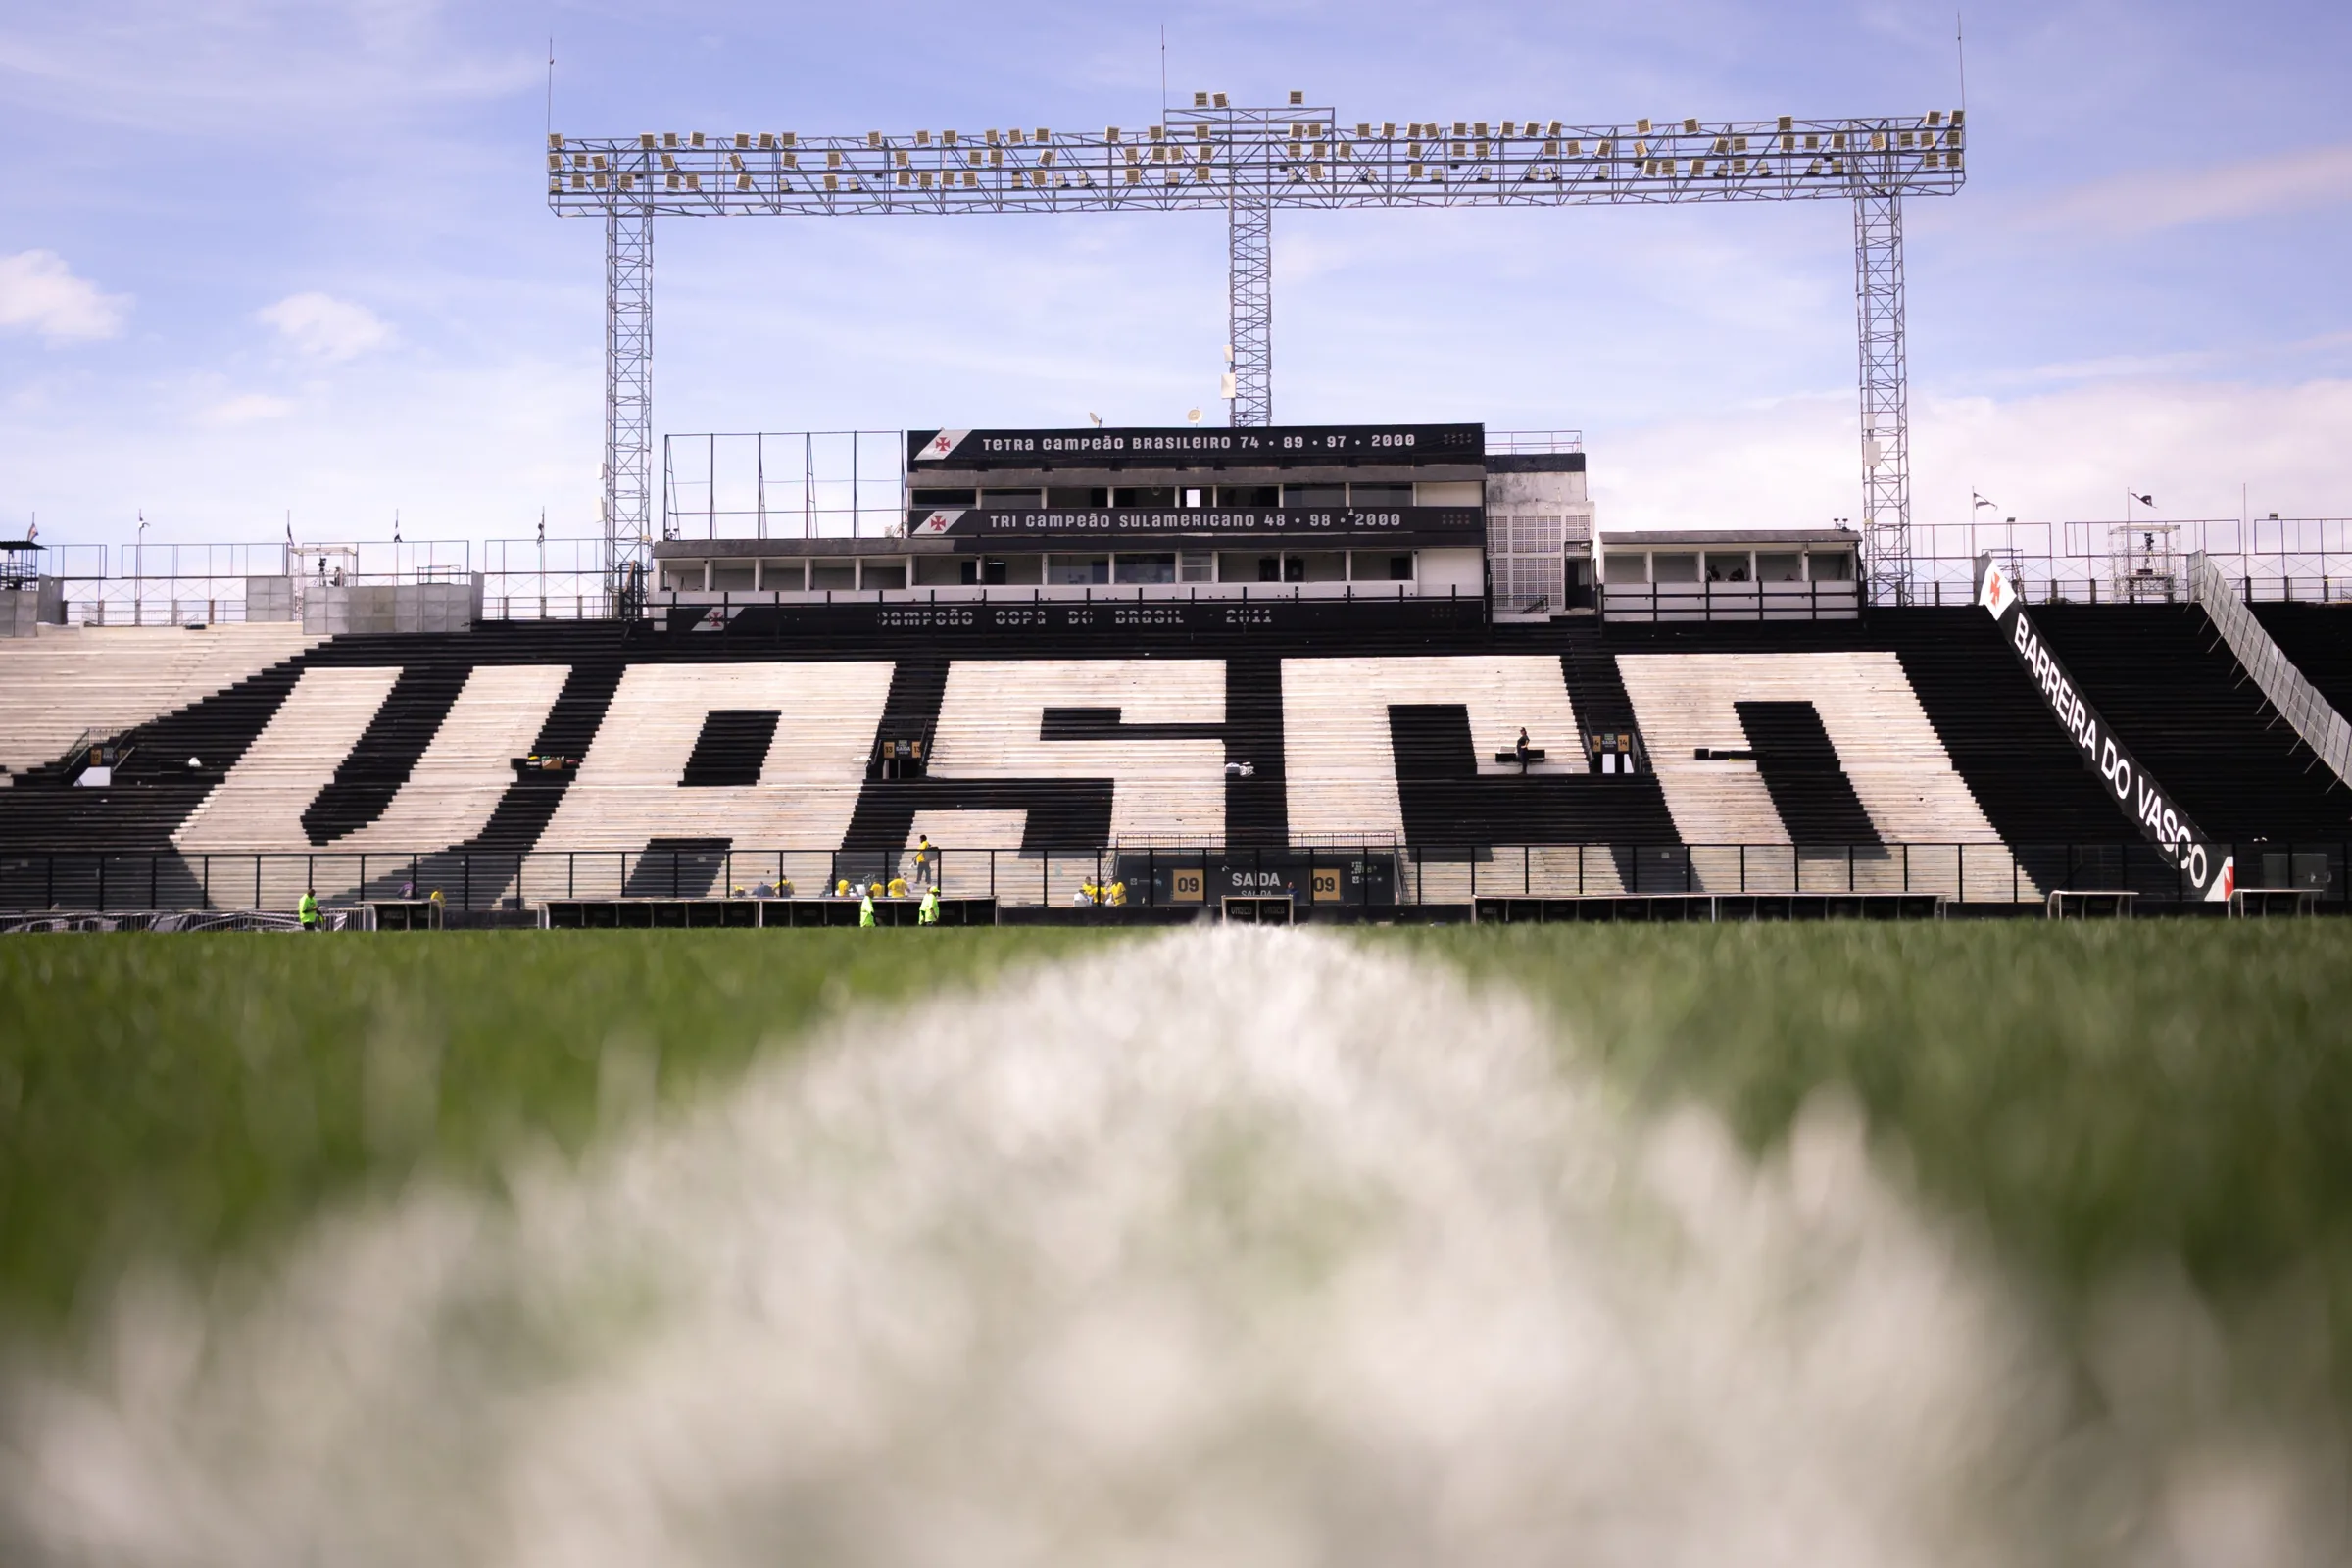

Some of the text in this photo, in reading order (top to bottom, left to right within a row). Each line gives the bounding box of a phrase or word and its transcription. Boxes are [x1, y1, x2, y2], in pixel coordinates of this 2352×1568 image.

[1240, 436, 1260, 449] 74
[1283, 436, 1303, 448] 89
[1327, 435, 1347, 448] 97
[1371, 434, 1415, 447] 2000
[990, 514, 1016, 528] TRI
[1264, 513, 1286, 527] 48
[1309, 513, 1331, 527] 98
[1354, 513, 1400, 526] 2000
[2014, 612, 2208, 889] BARREIRA DO VASCO
[1178, 877, 1200, 892] 09
[1312, 876, 1336, 893] 09
